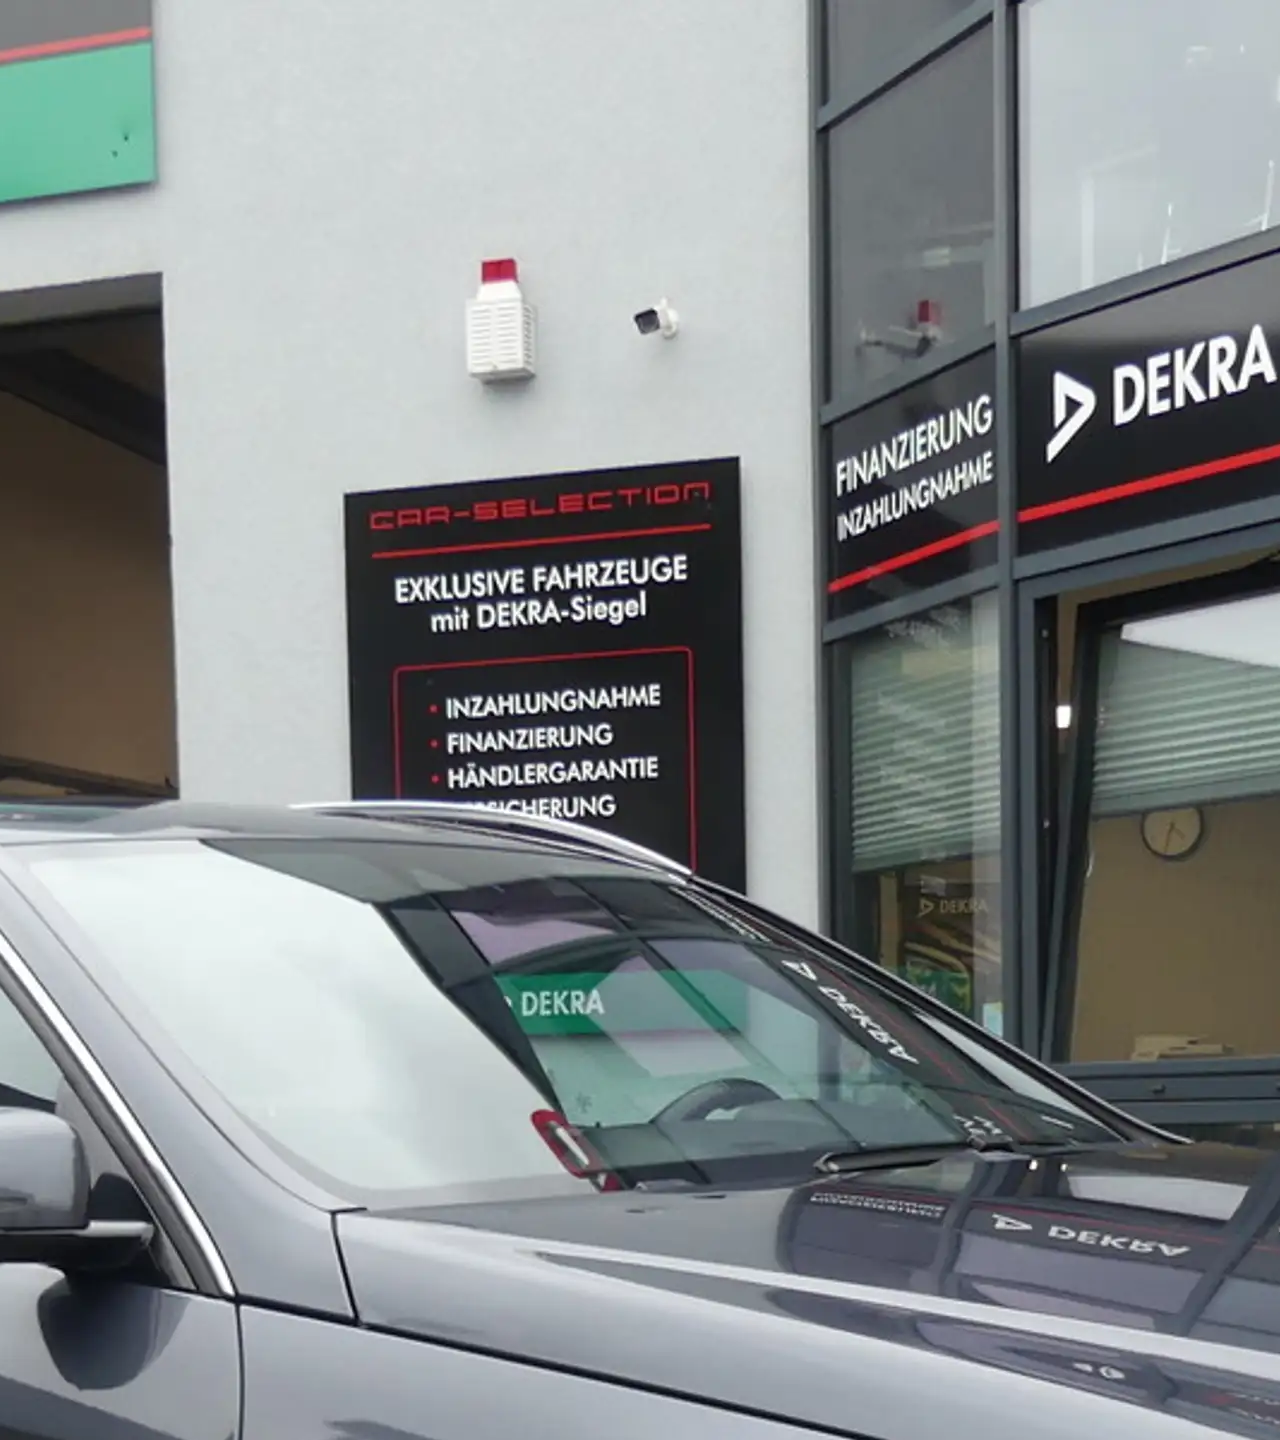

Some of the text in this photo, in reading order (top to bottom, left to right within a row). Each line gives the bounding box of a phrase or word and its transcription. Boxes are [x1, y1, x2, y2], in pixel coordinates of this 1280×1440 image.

[1113, 323, 1278, 427] DEKRA
[836, 394, 993, 498] FINANZIERUNG
[370, 481, 710, 531] CAR-SELECTION
[837, 450, 994, 542] INZAHLUNGNAHME
[394, 554, 688, 604] EXKLUSIVE FAHRZEUGE
[430, 591, 647, 633] mit DEKRA-Siegel
[445, 684, 661, 720] INZAHLUNGNAHME
[446, 723, 613, 755] FINANZIERUNG
[447, 756, 659, 790] HÄNDLERGARANTIE
[521, 989, 606, 1017] DEKRA
